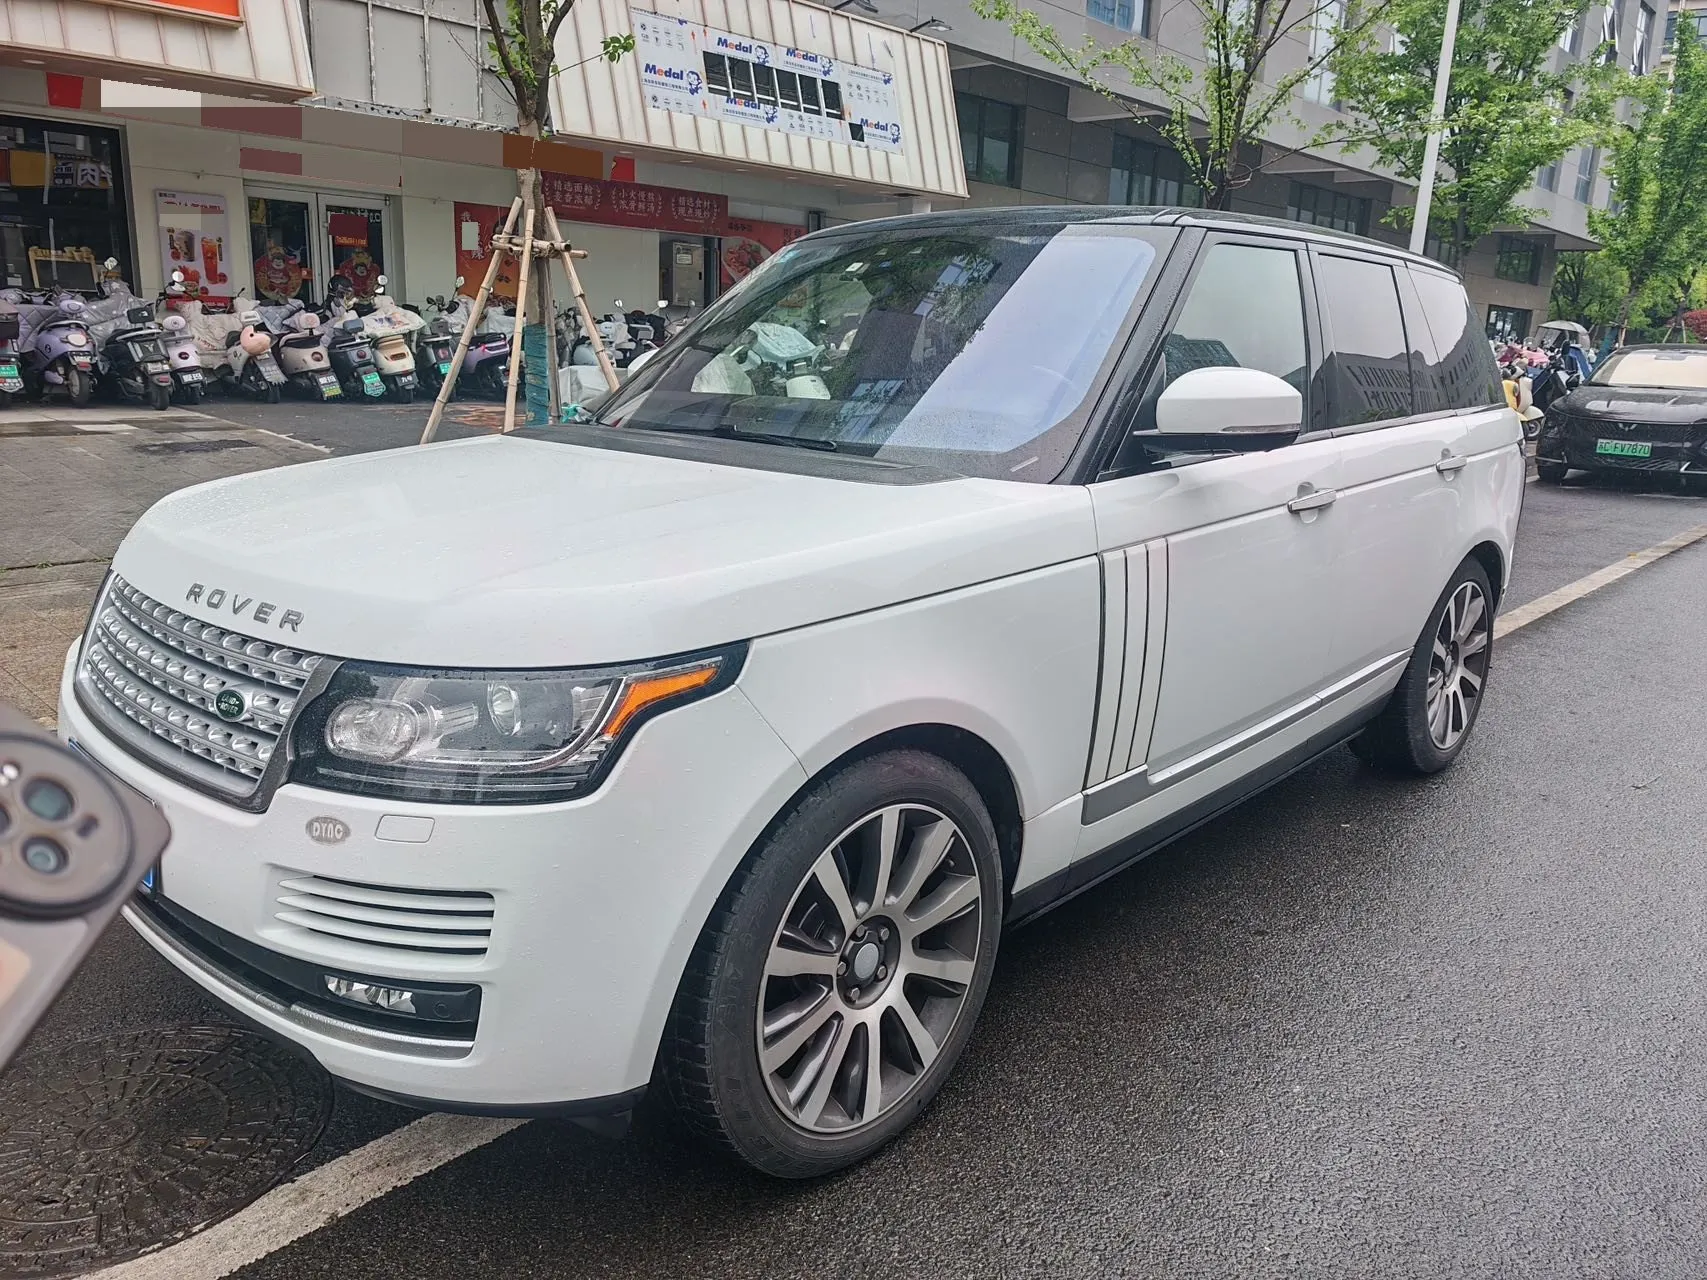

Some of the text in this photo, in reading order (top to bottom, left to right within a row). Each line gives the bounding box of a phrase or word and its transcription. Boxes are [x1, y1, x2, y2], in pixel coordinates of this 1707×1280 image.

[717, 37, 753, 54] Medal
[785, 47, 819, 63] Medal
[644, 63, 684, 81] Medal
[860, 118, 889, 132] Medal
[185, 582, 305, 633] ROVER
